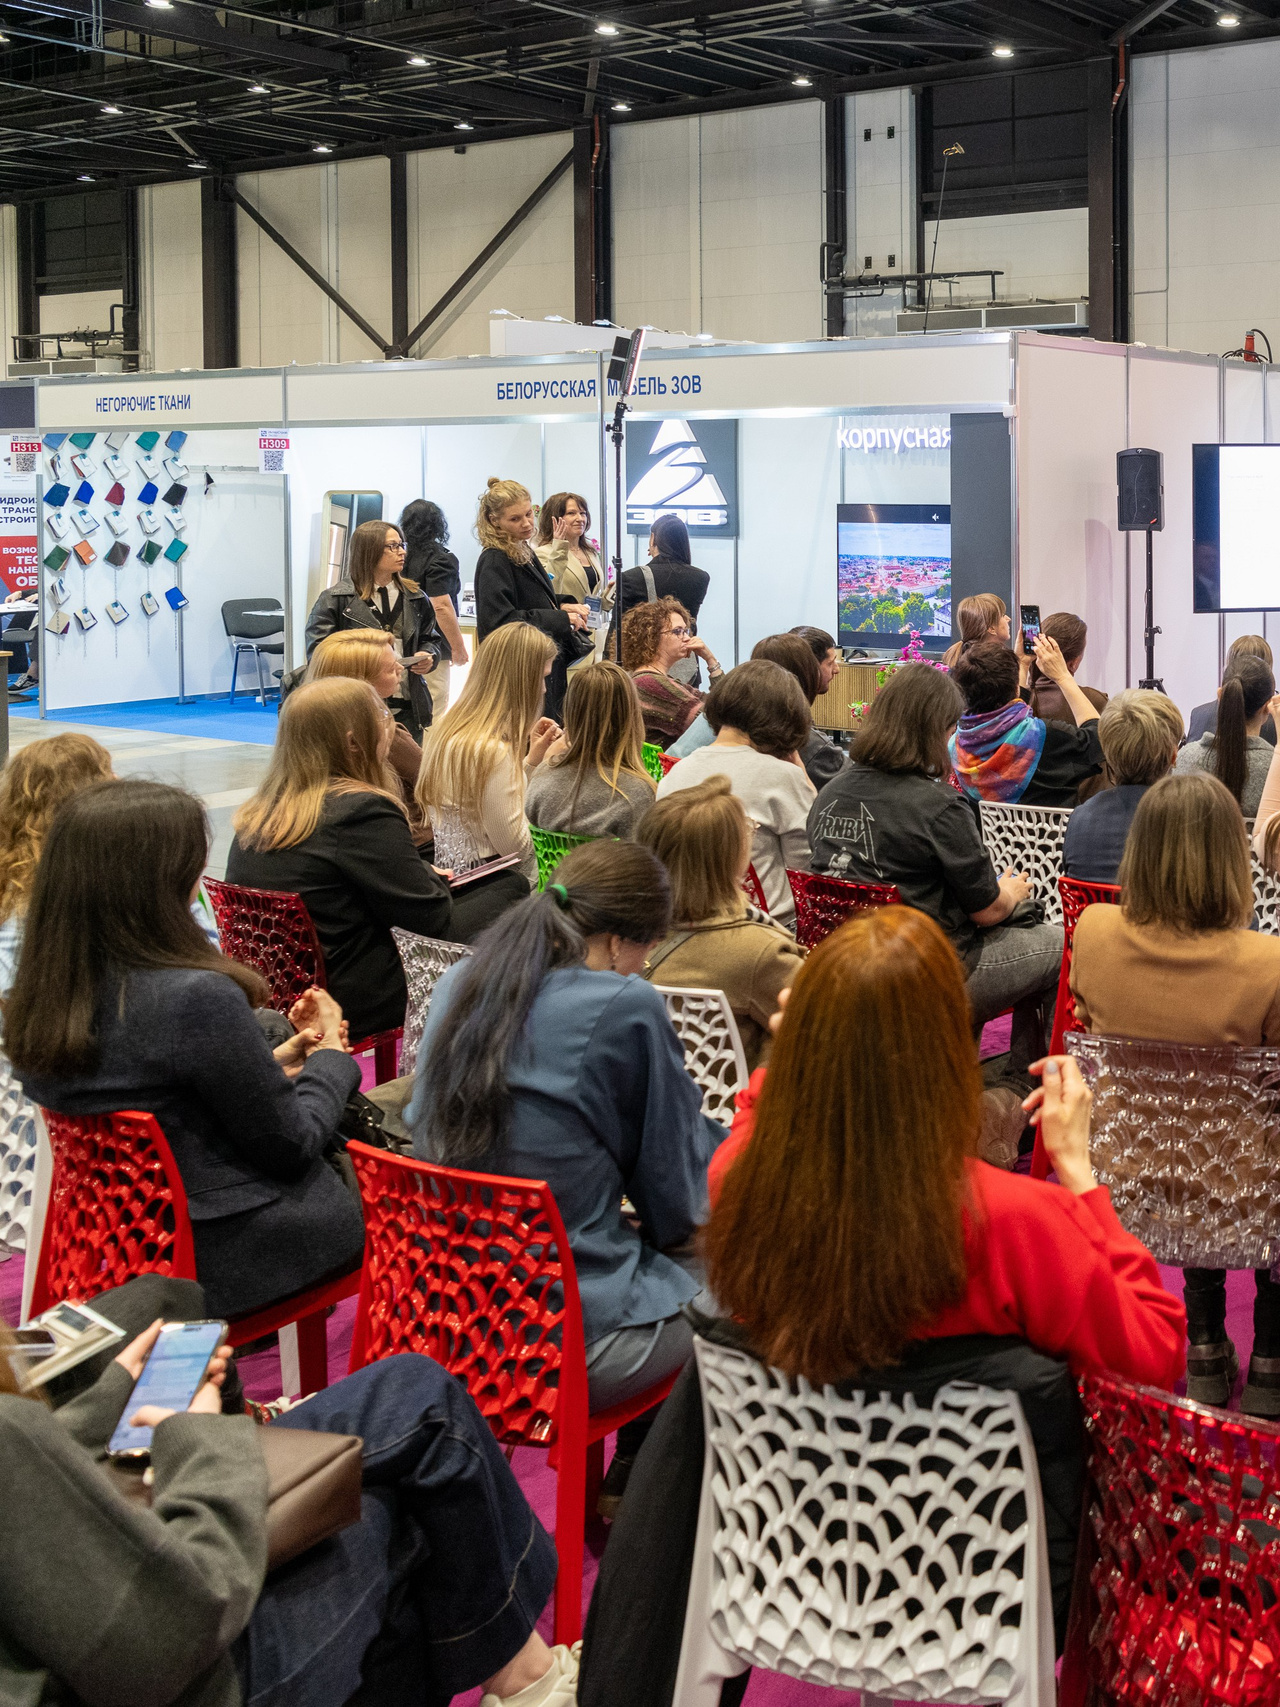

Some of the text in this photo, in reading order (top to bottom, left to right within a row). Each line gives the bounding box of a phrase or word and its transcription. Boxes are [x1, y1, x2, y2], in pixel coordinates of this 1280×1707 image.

[496, 379, 597, 401] БЕЛОРУССКАЯ
[607, 376, 667, 397] МЕЛЬ
[671, 375, 702, 395] ЗОВ
[95, 394, 191, 413] НЕГОРЮЧИЕ ТКАНИ
[12, 443, 39, 452] H313
[260, 439, 287, 449] H309
[836, 426, 952, 454] корпусная
